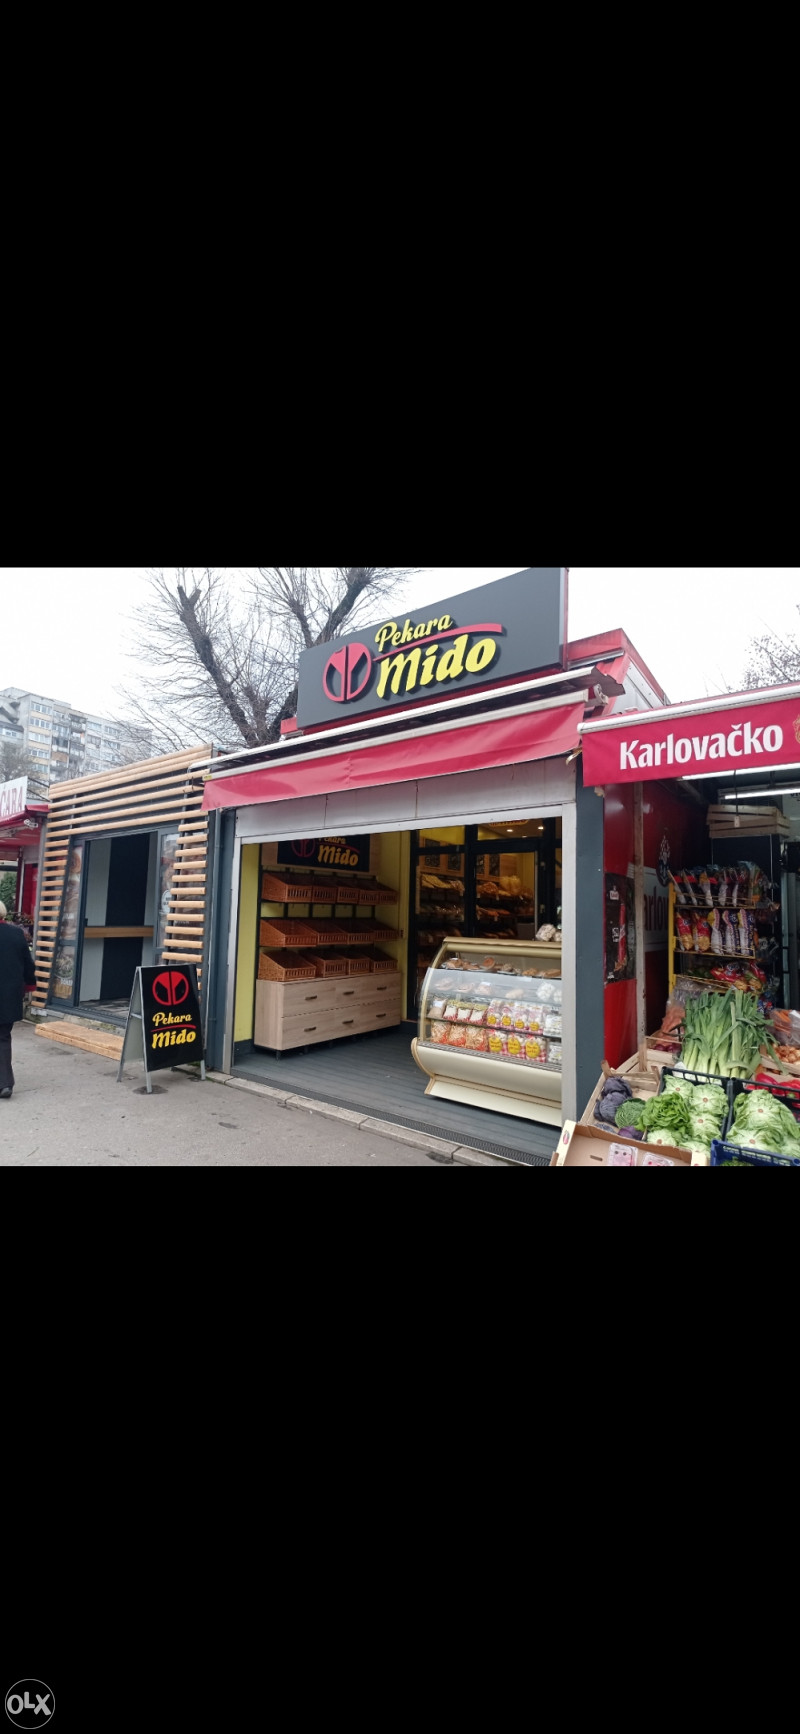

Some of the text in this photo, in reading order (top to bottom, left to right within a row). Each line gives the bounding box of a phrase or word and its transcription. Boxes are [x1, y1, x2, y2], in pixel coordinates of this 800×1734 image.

[374, 614, 454, 652] Pekara
[376, 634, 497, 699] Mido
[619, 721, 784, 770] Karlovačko
[317, 844, 359, 866] Mido
[152, 1012, 192, 1027] Pekara
[151, 1029, 197, 1049] Mido
